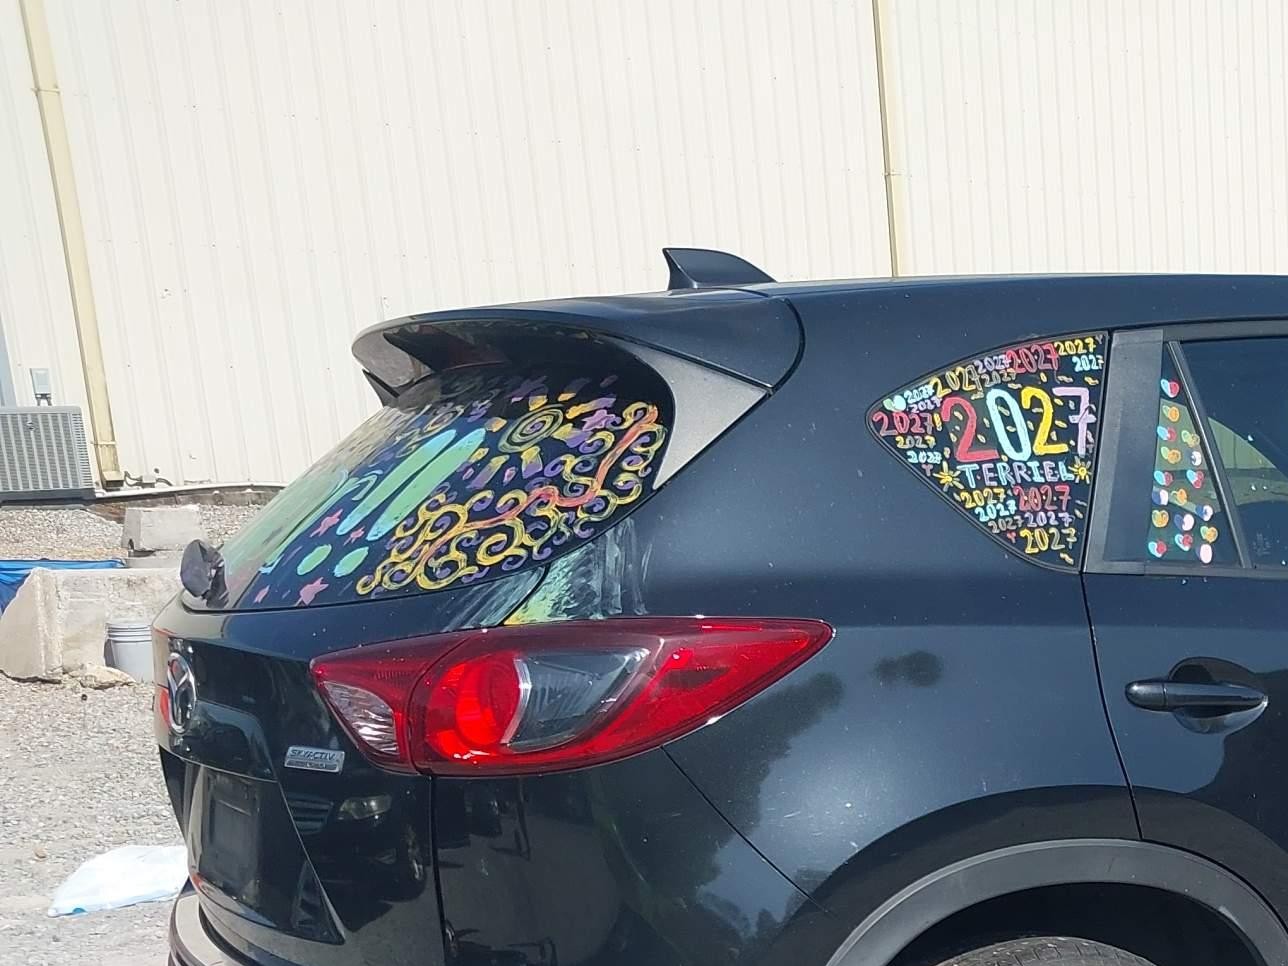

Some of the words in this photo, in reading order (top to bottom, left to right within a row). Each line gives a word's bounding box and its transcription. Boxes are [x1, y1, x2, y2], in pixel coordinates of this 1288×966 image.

[1054, 337, 1095, 355] 2027
[1006, 343, 1059, 374] 2027
[1072, 355, 1104, 372] 2027
[930, 364, 984, 398] 2027
[908, 396, 943, 413] 2027
[872, 411, 934, 436] 2027
[941, 386, 1097, 462] 2027
[895, 435, 936, 449] 2027
[959, 487, 1006, 508] 2027
[1013, 485, 1071, 512] 2027
[975, 500, 1018, 522] 2027
[1024, 511, 1075, 527] 2027
[987, 515, 1024, 533] 2027
[1019, 527, 1077, 554] 2027
